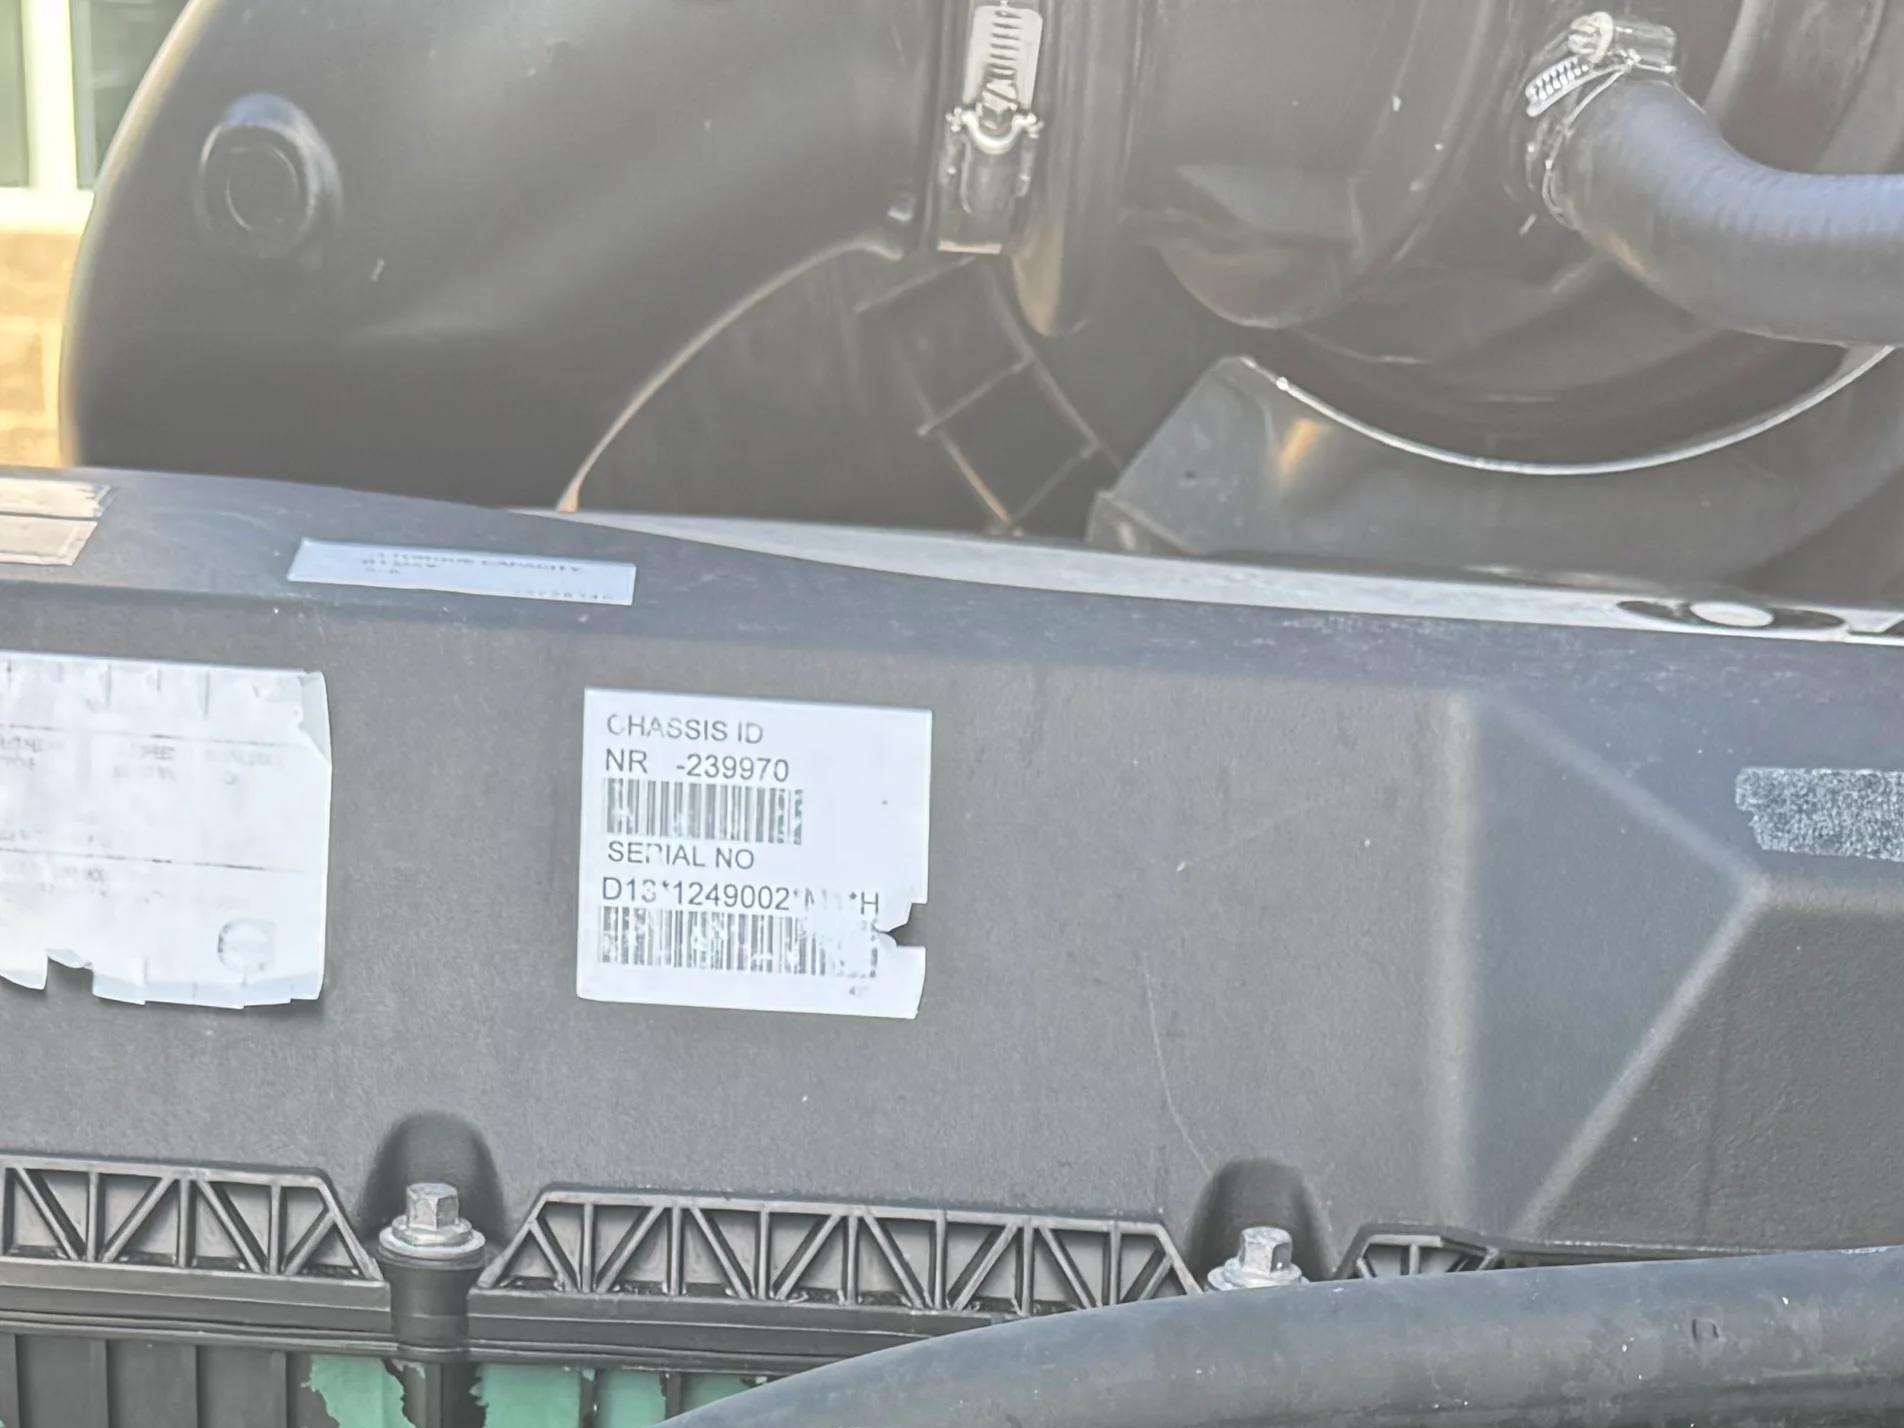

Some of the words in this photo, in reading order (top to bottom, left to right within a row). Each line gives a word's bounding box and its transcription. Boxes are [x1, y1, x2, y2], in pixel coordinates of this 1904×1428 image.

[607, 714, 727, 742] CHASSIS
[737, 720, 763, 744] ID
[605, 748, 647, 774] NR
[676, 753, 789, 782] -239970
[608, 841, 705, 868] SERIAL
[714, 847, 754, 870] NO
